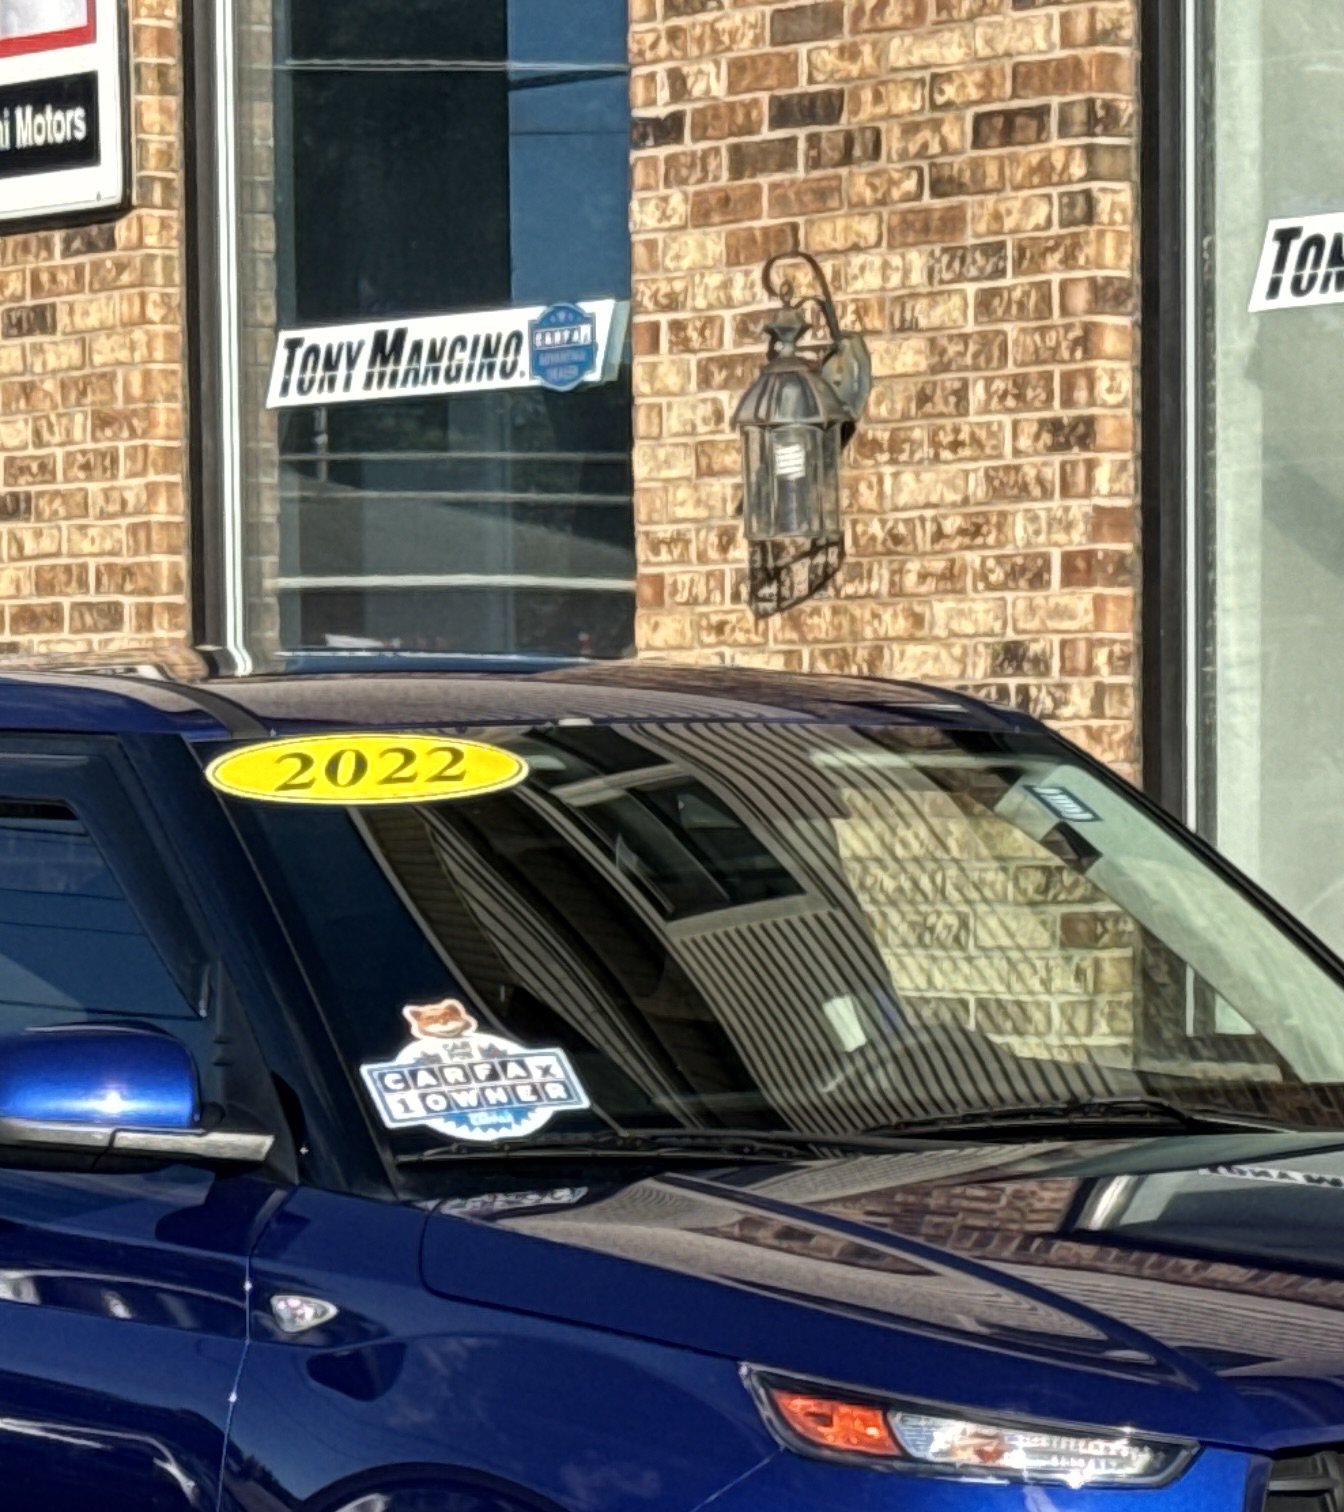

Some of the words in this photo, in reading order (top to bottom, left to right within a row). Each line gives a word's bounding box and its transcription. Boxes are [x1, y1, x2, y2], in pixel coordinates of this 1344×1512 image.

[15, 104, 87, 149] Motors
[274, 746, 467, 791] 2022
[380, 1060, 559, 1091] CARFAX
[423, 1083, 570, 1111] OWNER
